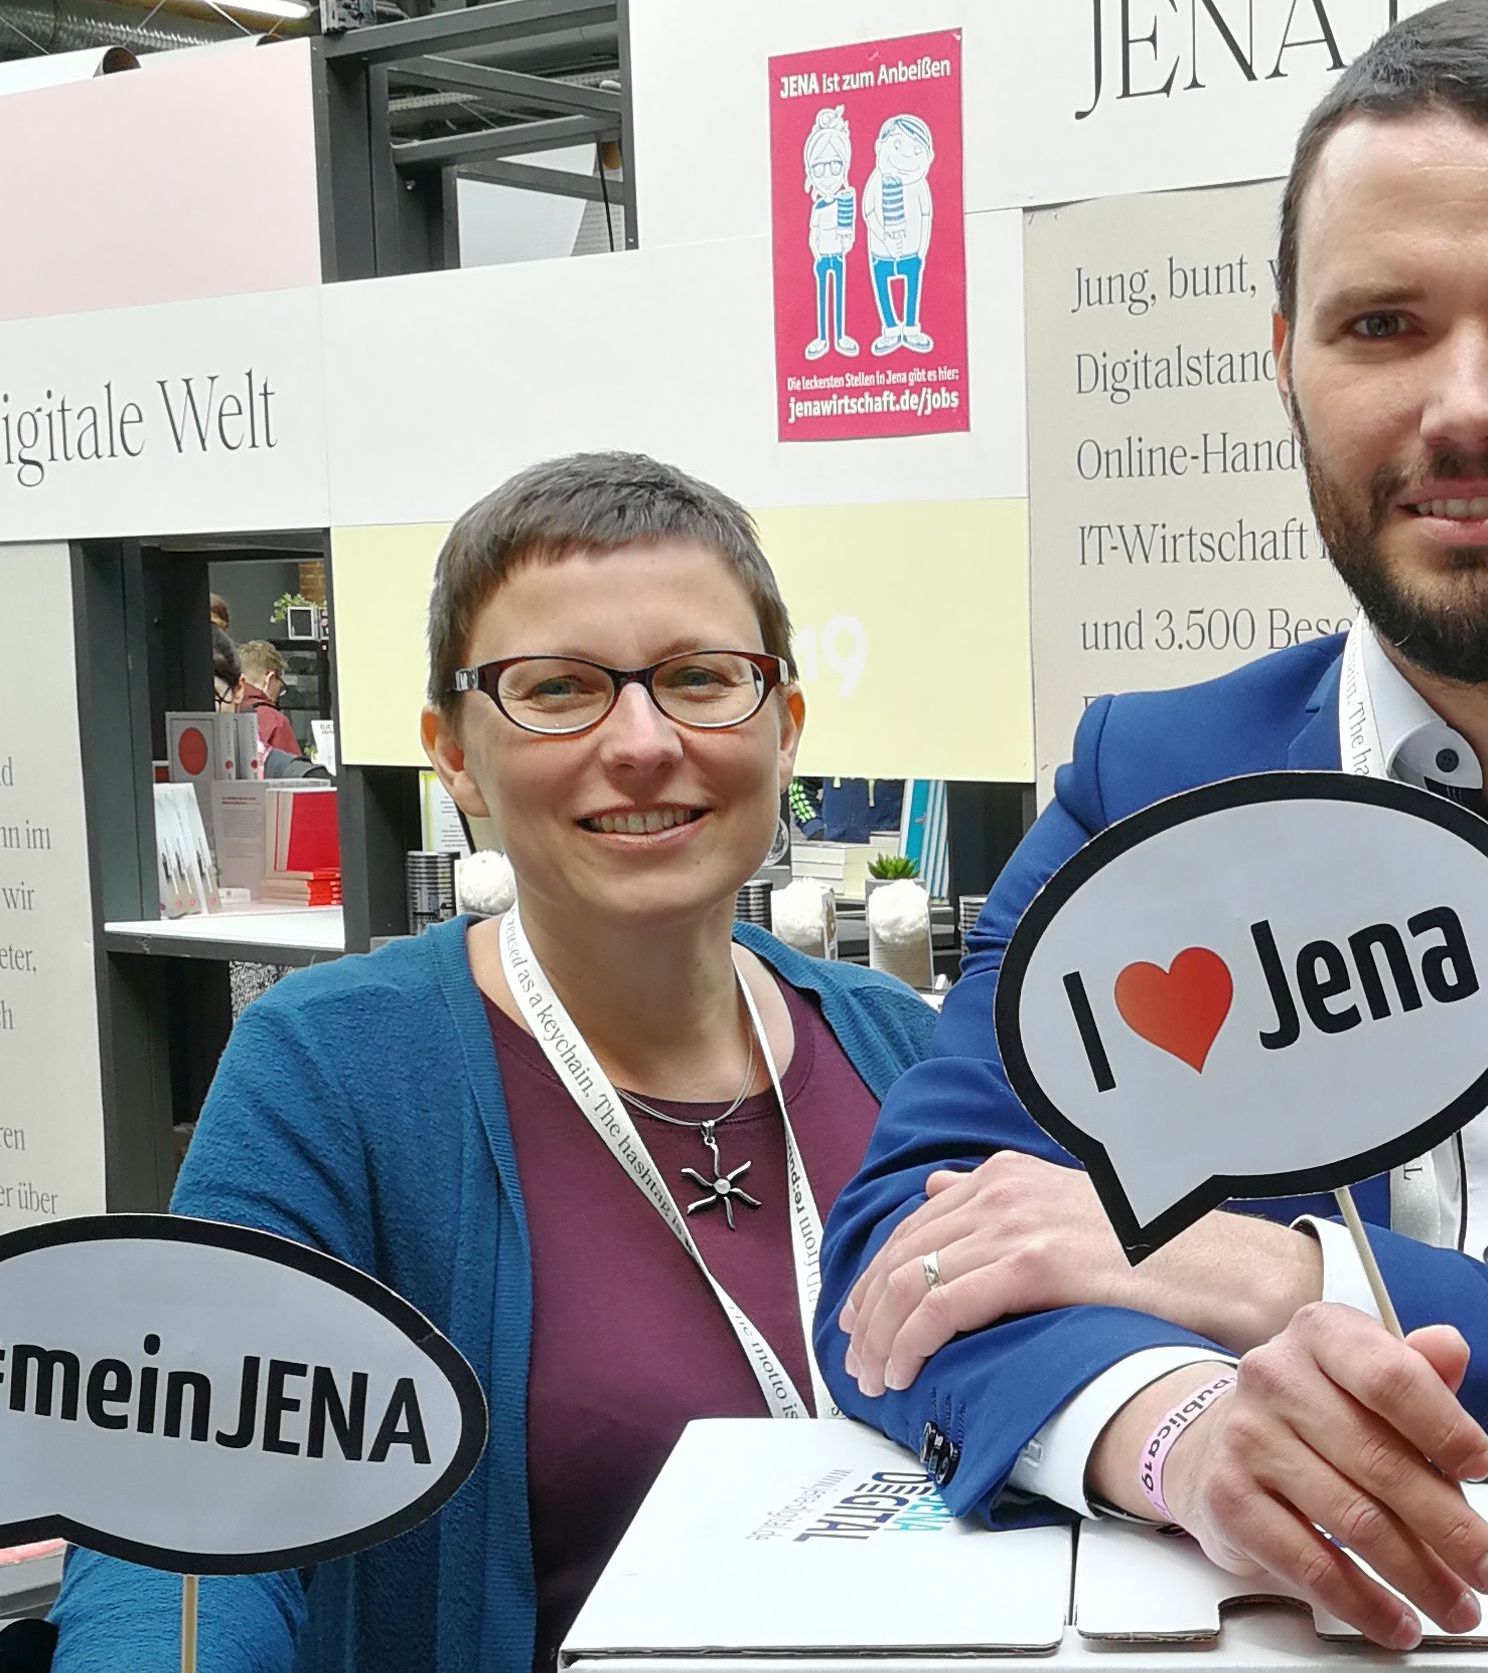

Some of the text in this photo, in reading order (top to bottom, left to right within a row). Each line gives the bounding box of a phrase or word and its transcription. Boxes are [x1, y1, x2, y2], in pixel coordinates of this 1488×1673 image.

[779, 56, 951, 99] JENA ist zum Anbeißen
[1074, 0, 1347, 120] JENA
[1071, 266, 1156, 316] Jung,
[1167, 254, 1257, 299] bunt,
[787, 366, 960, 391] Die leckersten Stellen in Jena gibt es hier:
[156, 368, 279, 453] Welt
[788, 387, 960, 423] jenawirtschaft.de/jobs
[1079, 517, 1309, 565] IT-Wirtschaft
[1081, 609, 1145, 651] und
[1155, 608, 1256, 651] 3.500
[26, 819, 51, 850] im
[2, 881, 35, 911] wir
[1062, 906, 1480, 1093] I Jena
[517, 969, 535, 993] as
[529, 993, 543, 1008] a
[537, 1003, 595, 1098] keychain.
[594, 1094, 621, 1138] The
[18, 1181, 59, 1214] über
[752, 1342, 788, 1400] motto
